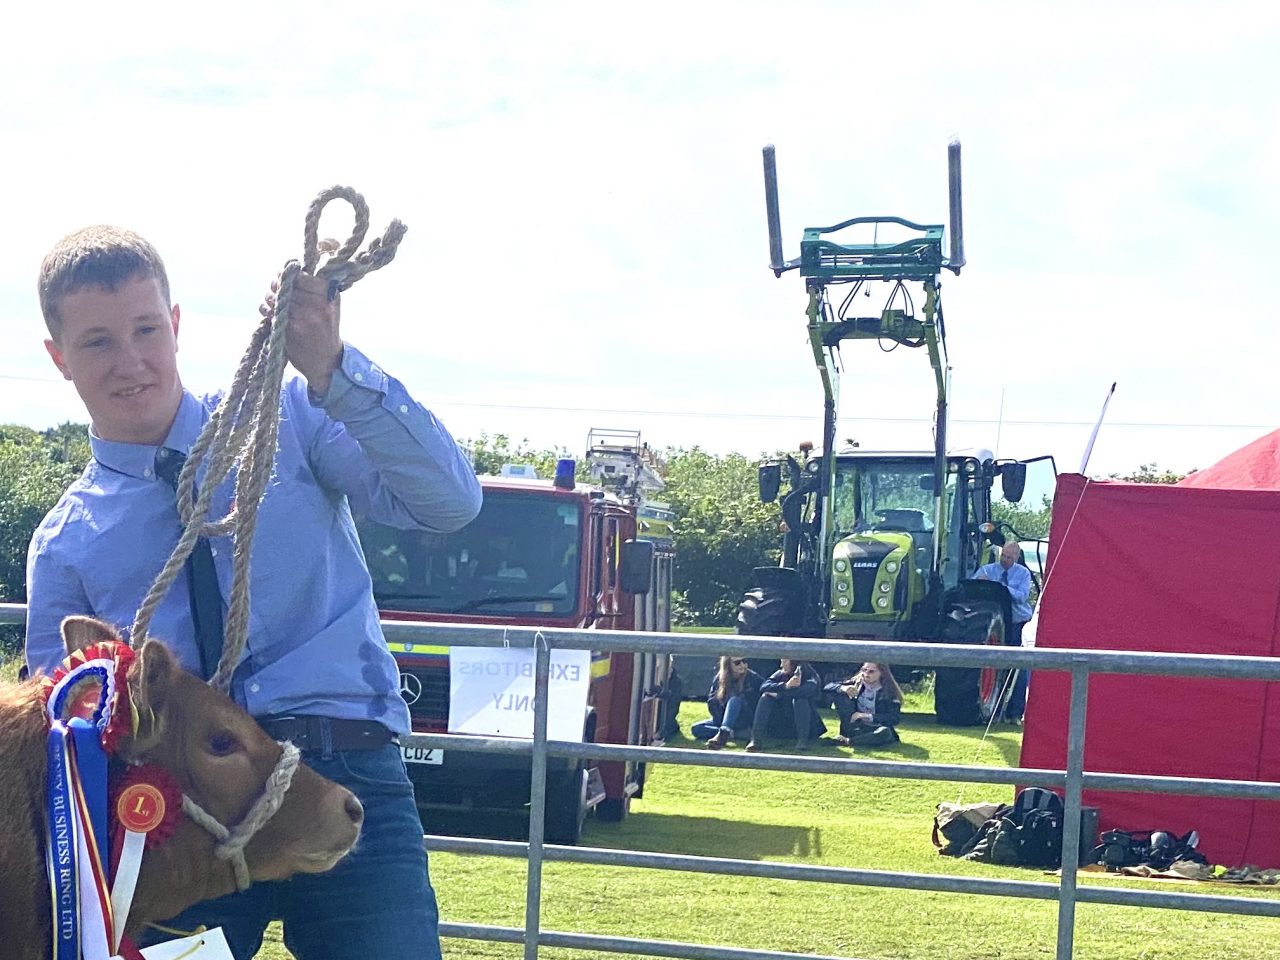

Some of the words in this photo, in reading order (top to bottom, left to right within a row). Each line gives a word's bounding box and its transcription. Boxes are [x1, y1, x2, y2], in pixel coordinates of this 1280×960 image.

[404, 747, 434, 761] CDZ
[53, 795, 71, 865] BUSINESS
[60, 866, 72, 906] RING
[62, 909, 73, 941] LTD
